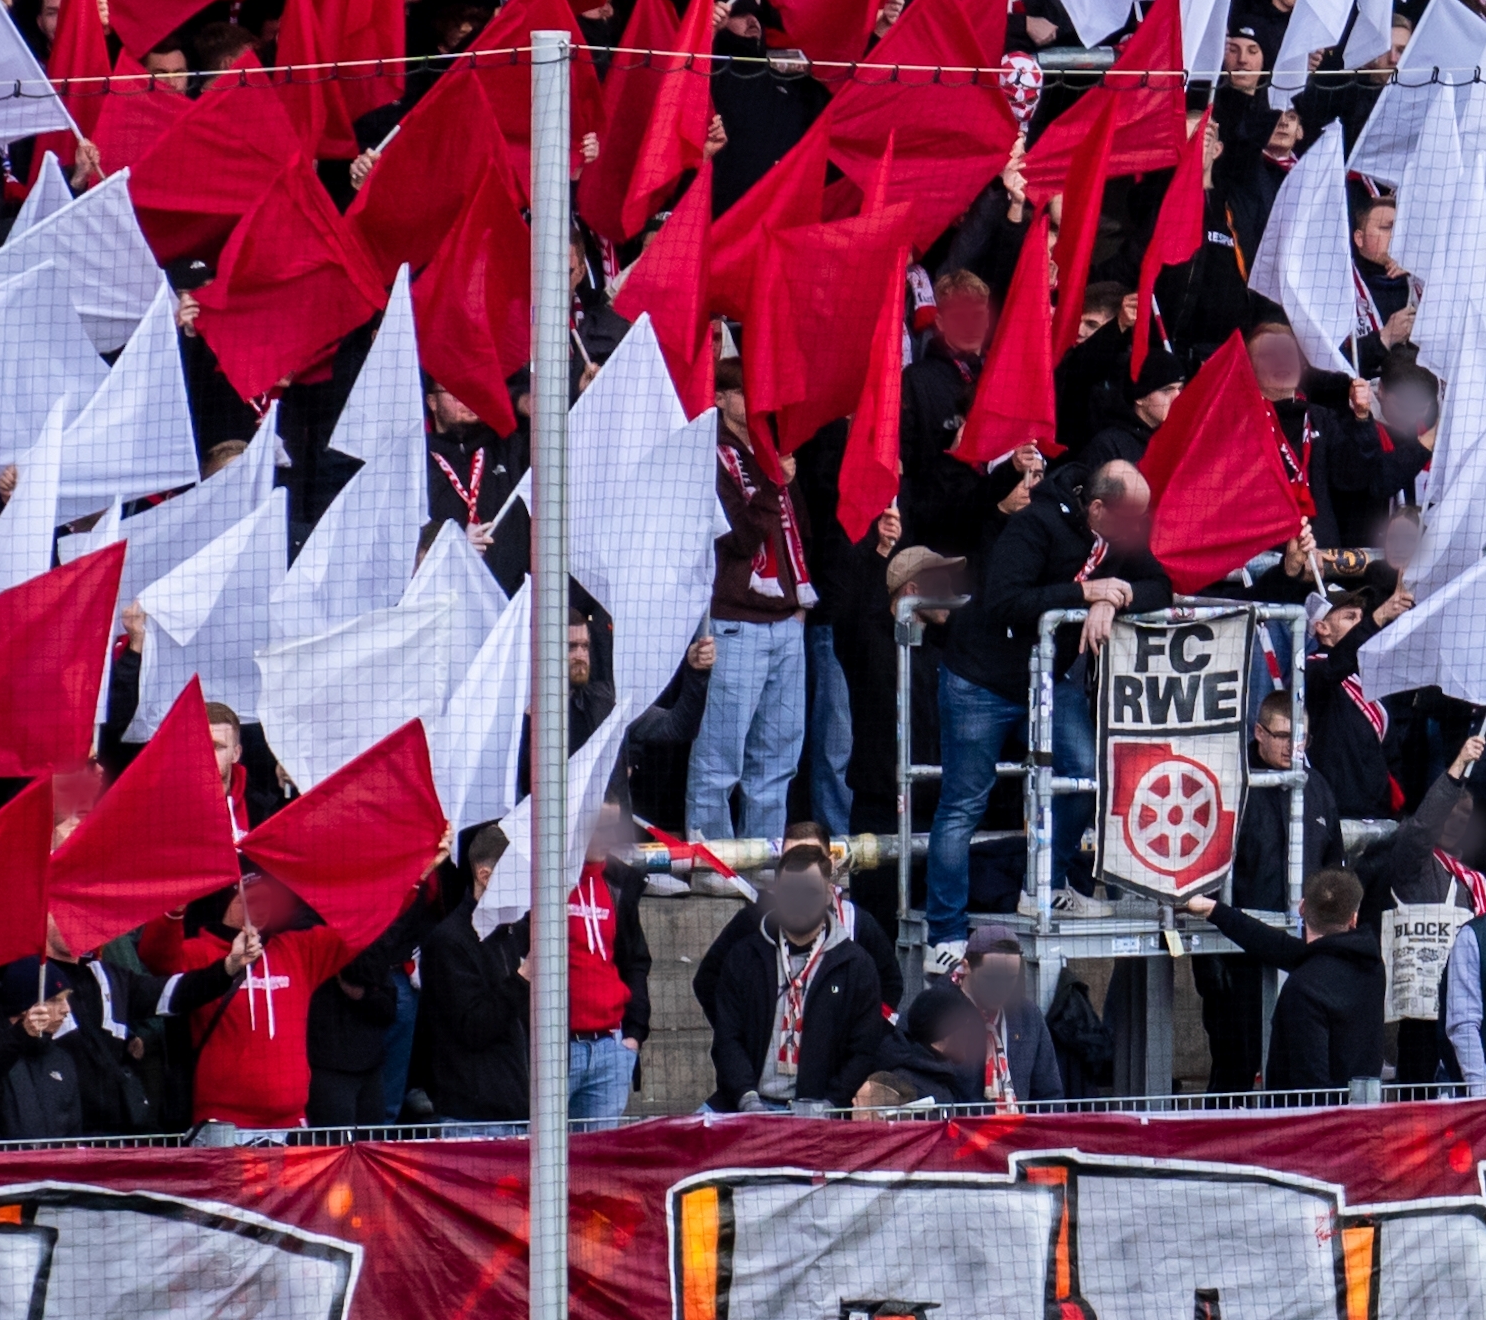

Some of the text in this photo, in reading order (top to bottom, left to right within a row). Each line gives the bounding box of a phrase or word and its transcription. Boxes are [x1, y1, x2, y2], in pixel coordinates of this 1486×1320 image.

[1134, 624, 1214, 673] FC
[1113, 670, 1239, 725] RWE
[1394, 922, 1451, 938] BLOCK
